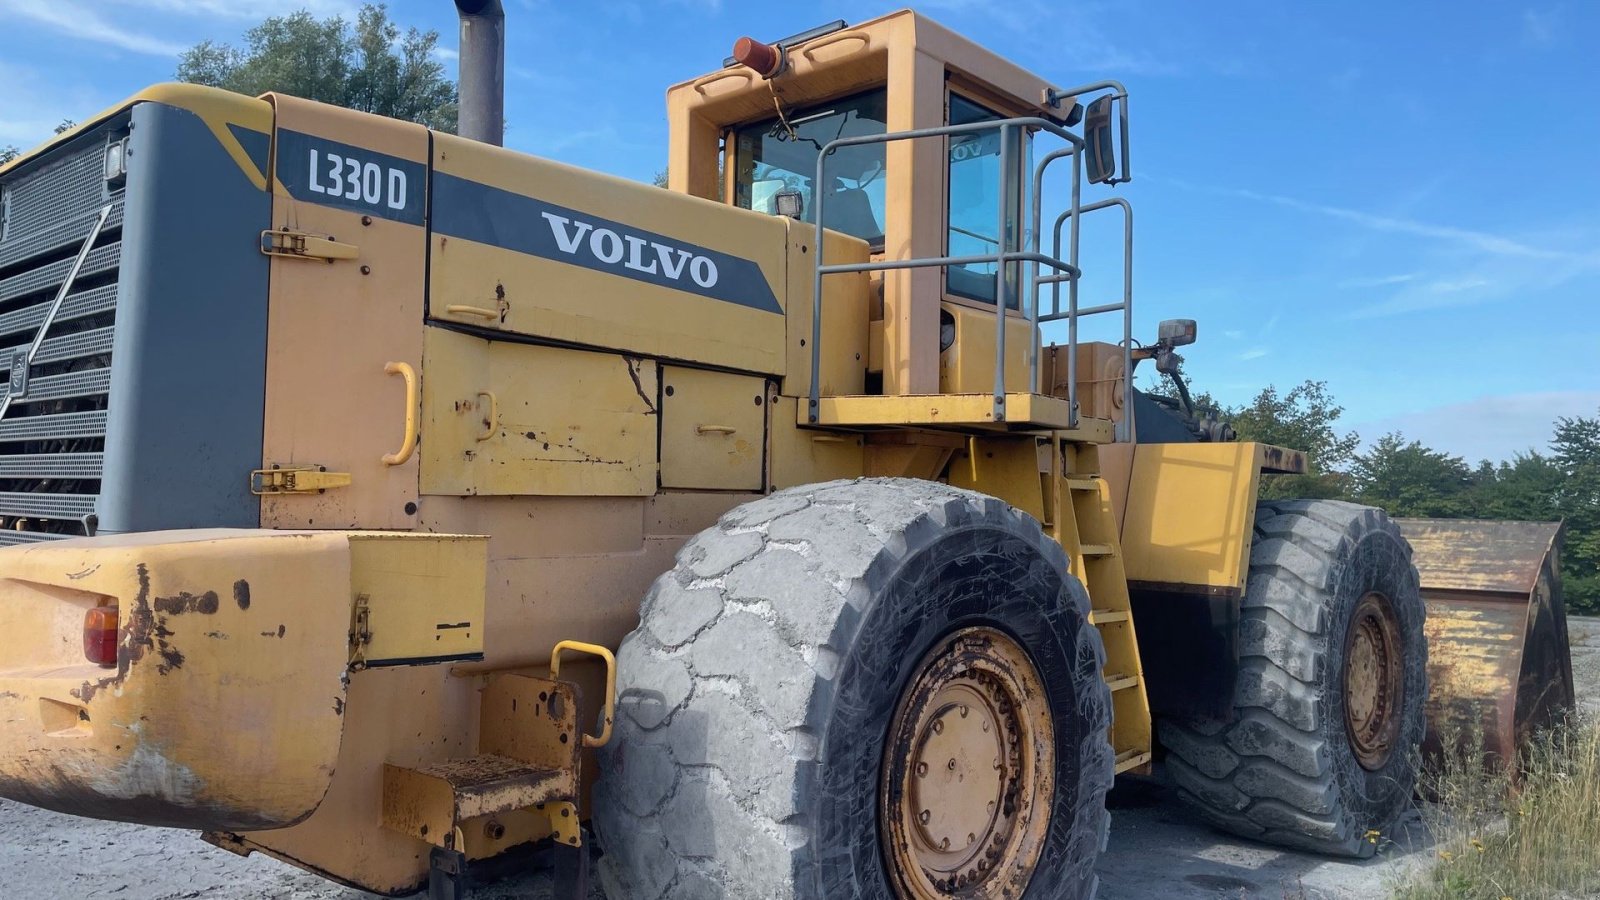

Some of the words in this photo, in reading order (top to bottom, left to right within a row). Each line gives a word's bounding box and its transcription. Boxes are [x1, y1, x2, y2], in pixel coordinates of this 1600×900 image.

[309, 148, 381, 204] L330
[387, 167, 407, 210] D
[541, 211, 718, 288] VOLVO
